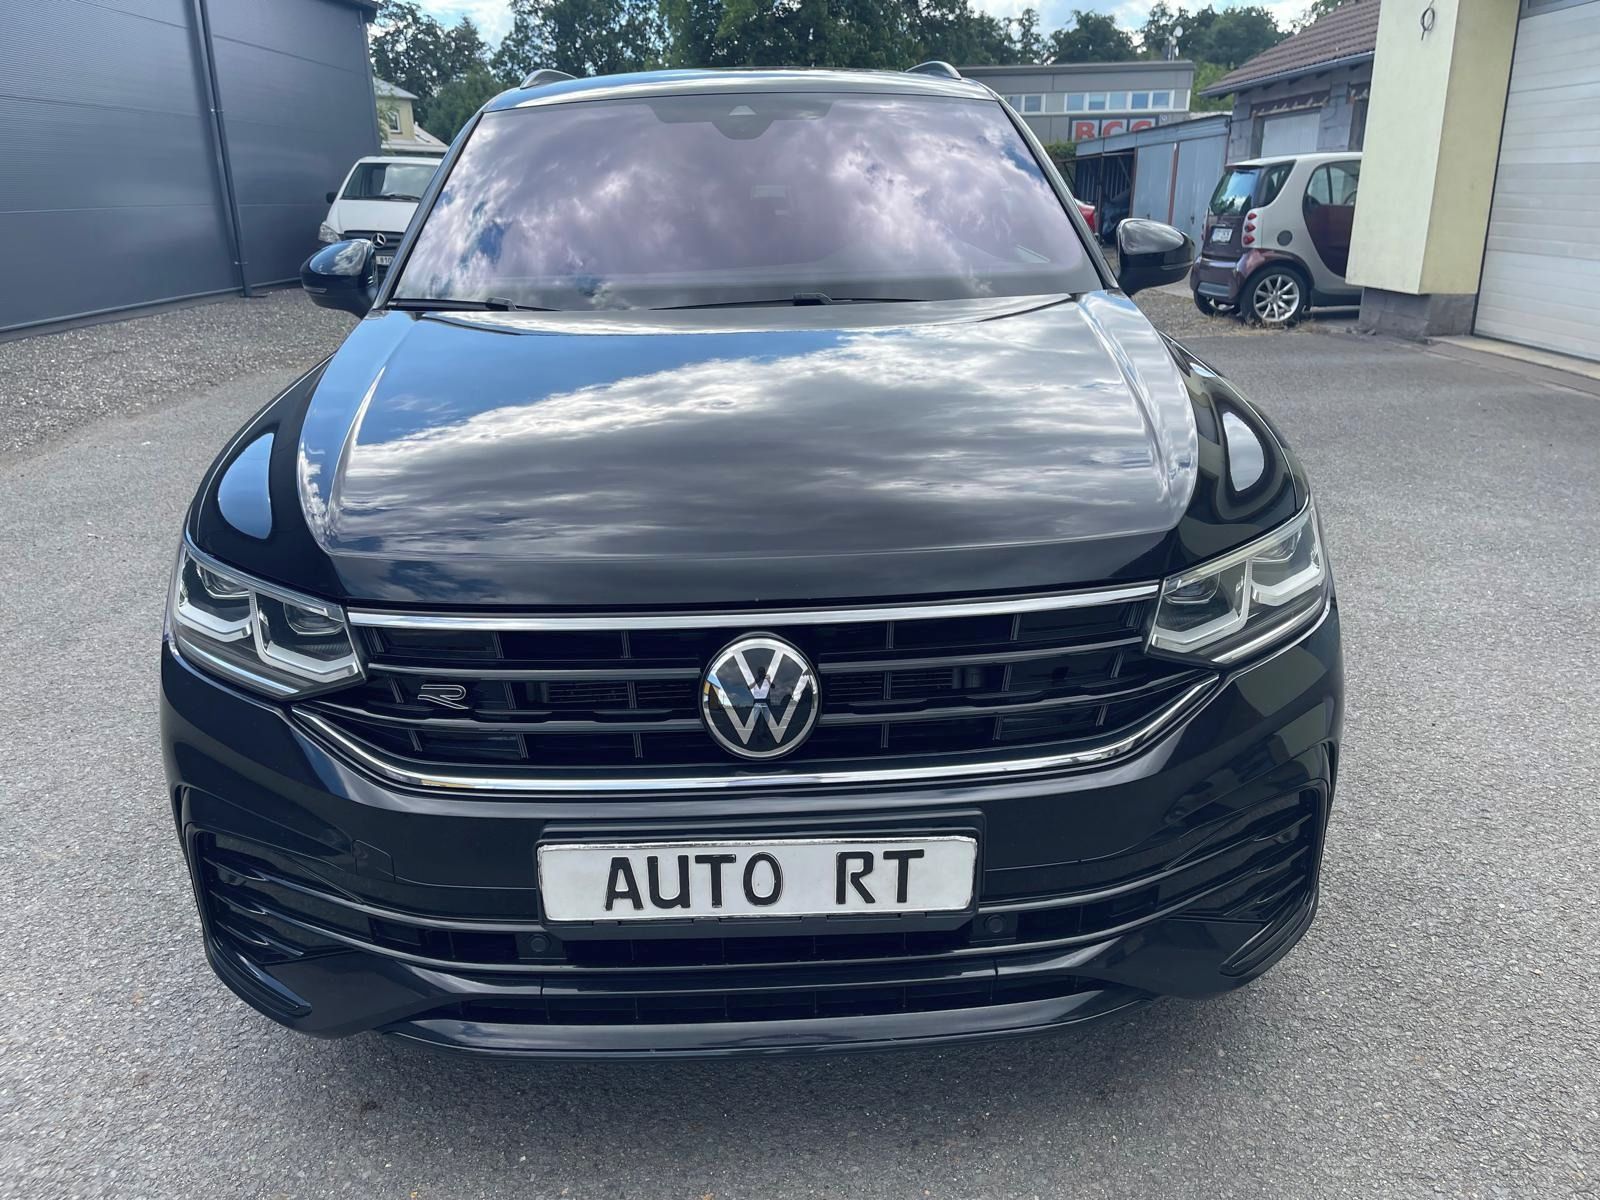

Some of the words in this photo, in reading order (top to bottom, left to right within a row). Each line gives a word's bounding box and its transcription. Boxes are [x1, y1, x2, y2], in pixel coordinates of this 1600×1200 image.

[418, 684, 469, 709] R
[604, 851, 784, 911] AUTO
[836, 848, 925, 905] RT
